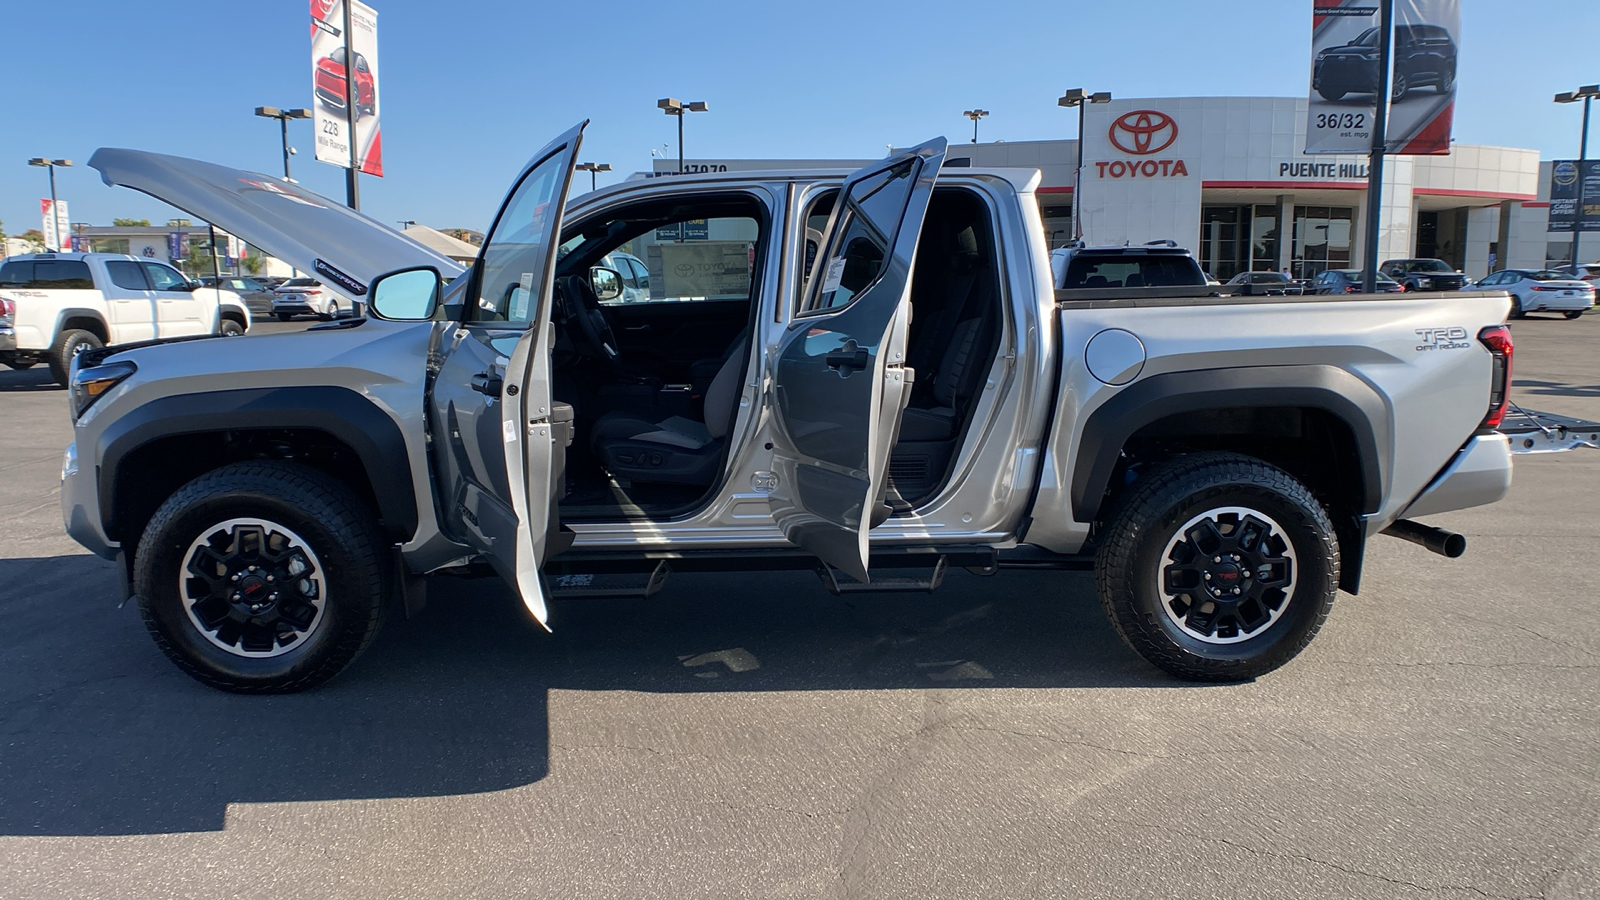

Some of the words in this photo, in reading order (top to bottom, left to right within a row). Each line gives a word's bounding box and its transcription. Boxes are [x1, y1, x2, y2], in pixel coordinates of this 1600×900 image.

[322, 119, 339, 137] 228
[1316, 113, 1365, 129] 36/32
[318, 135, 329, 147] Mile
[329, 139, 348, 153] Range
[1095, 160, 1188, 178] TOYOTA
[1280, 162, 1336, 178] PUENTE
[697, 262, 738, 271] TOYOTA
[1415, 326, 1468, 345] TRD
[1439, 342, 1471, 351] ROAD
[1218, 572, 1239, 580] TRD
